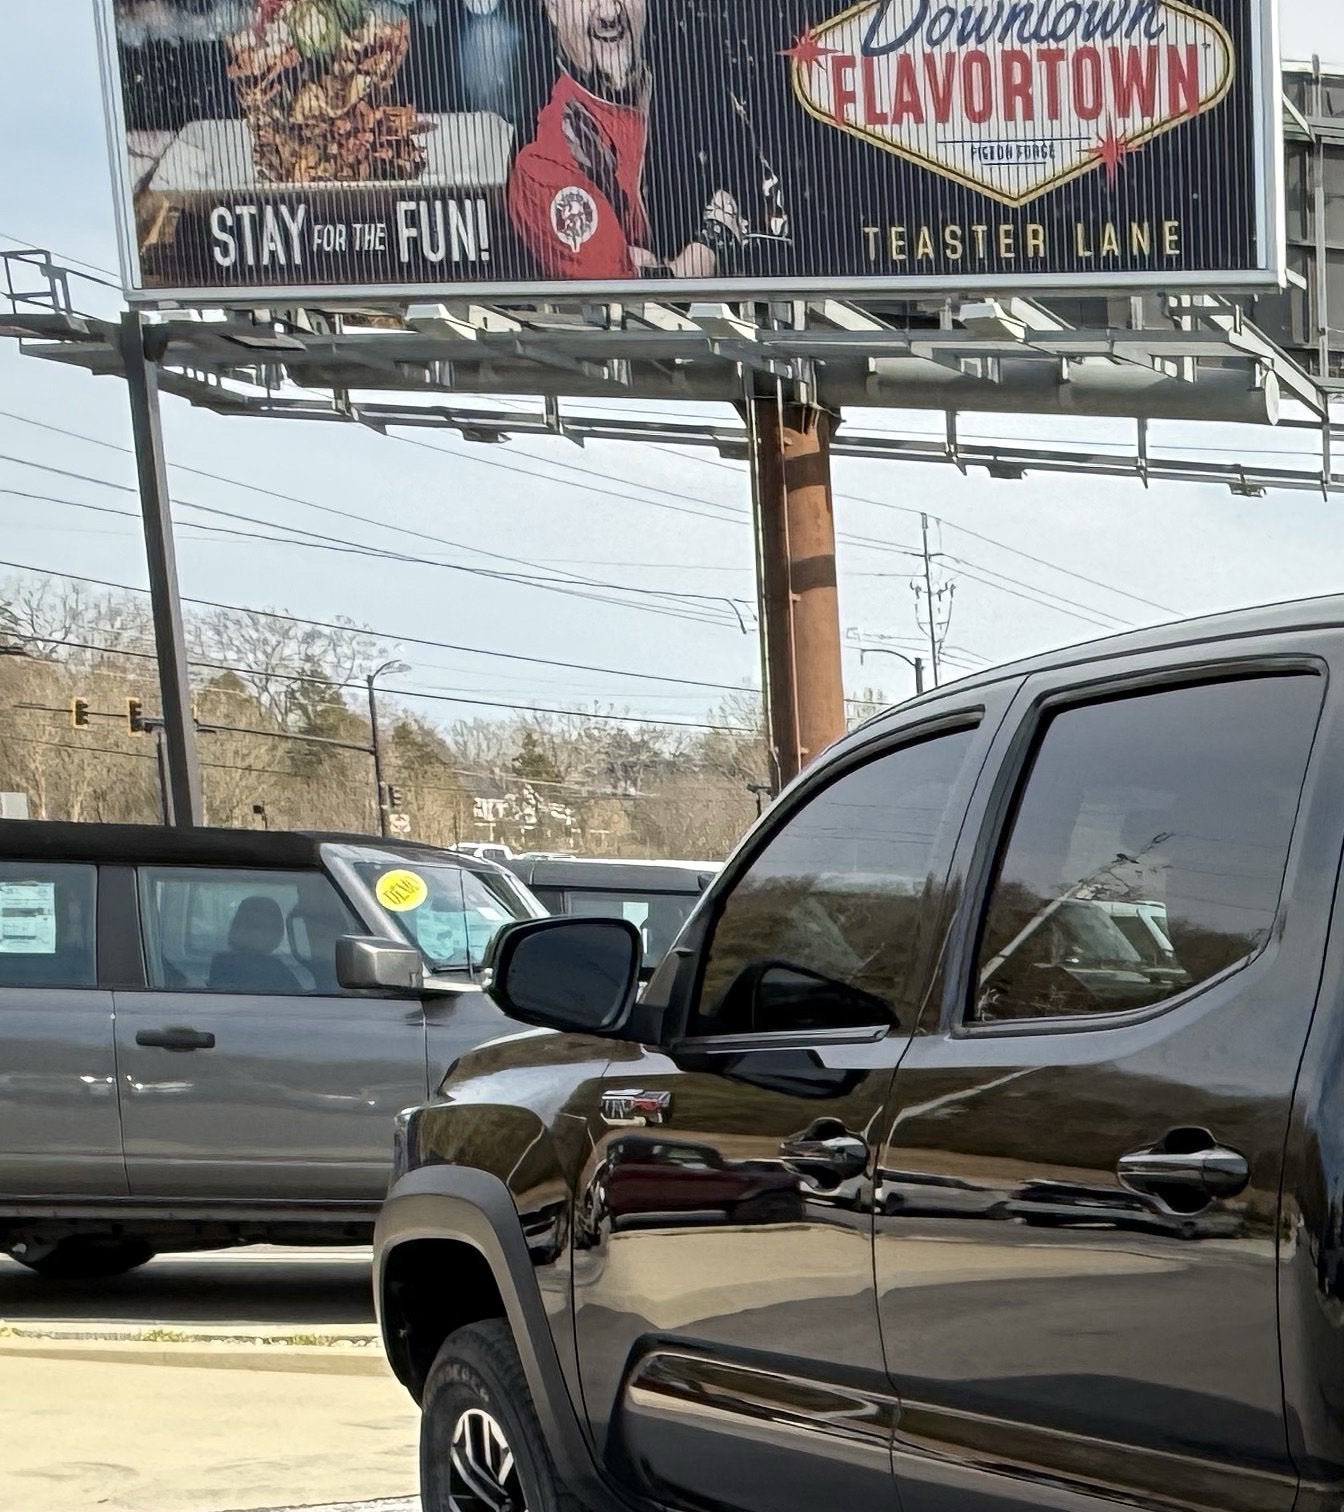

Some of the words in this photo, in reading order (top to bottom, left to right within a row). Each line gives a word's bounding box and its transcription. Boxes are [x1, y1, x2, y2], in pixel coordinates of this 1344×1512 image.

[831, 44, 1201, 127] FLAVORTOWN
[210, 203, 306, 266] STAY
[312, 224, 346, 251] FOR
[352, 223, 386, 250] THE
[396, 198, 490, 262] FUN!
[863, 223, 1045, 260] TEASTER
[1077, 220, 1180, 257] LANE
